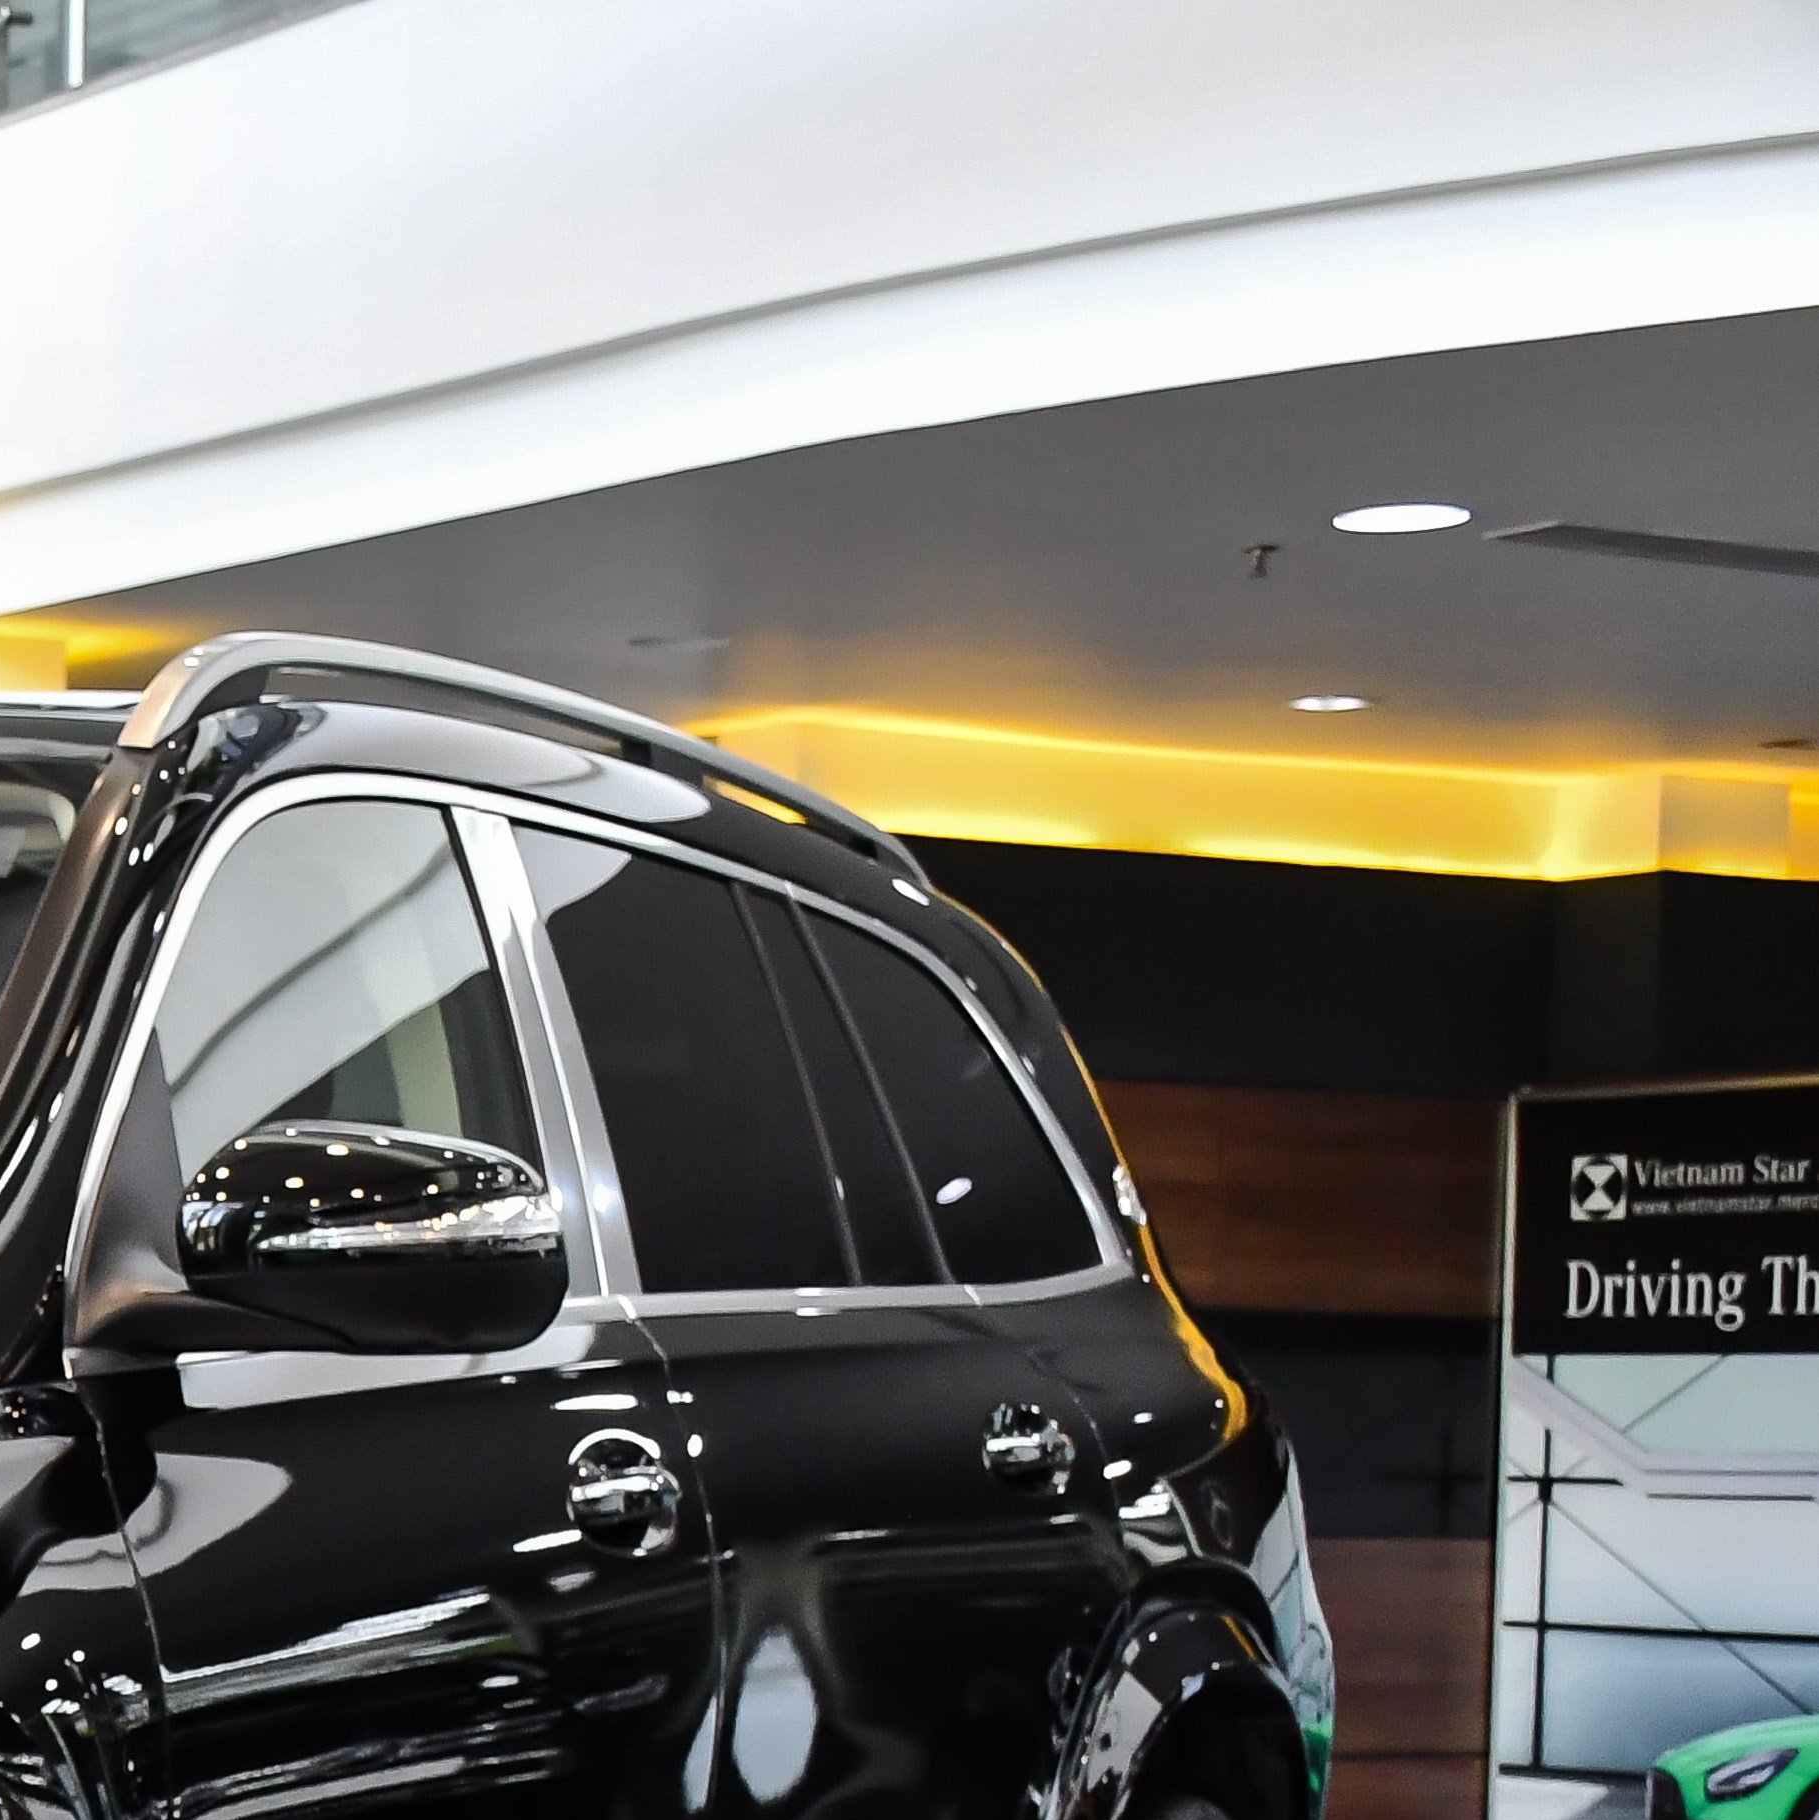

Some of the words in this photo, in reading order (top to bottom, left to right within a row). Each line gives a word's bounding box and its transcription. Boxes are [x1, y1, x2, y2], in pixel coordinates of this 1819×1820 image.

[1633, 1159, 1746, 1188] Vietnam
[1753, 1154, 1811, 1183] Star
[1564, 1258, 1747, 1332] Driving
[1762, 1255, 1819, 1315] Th
